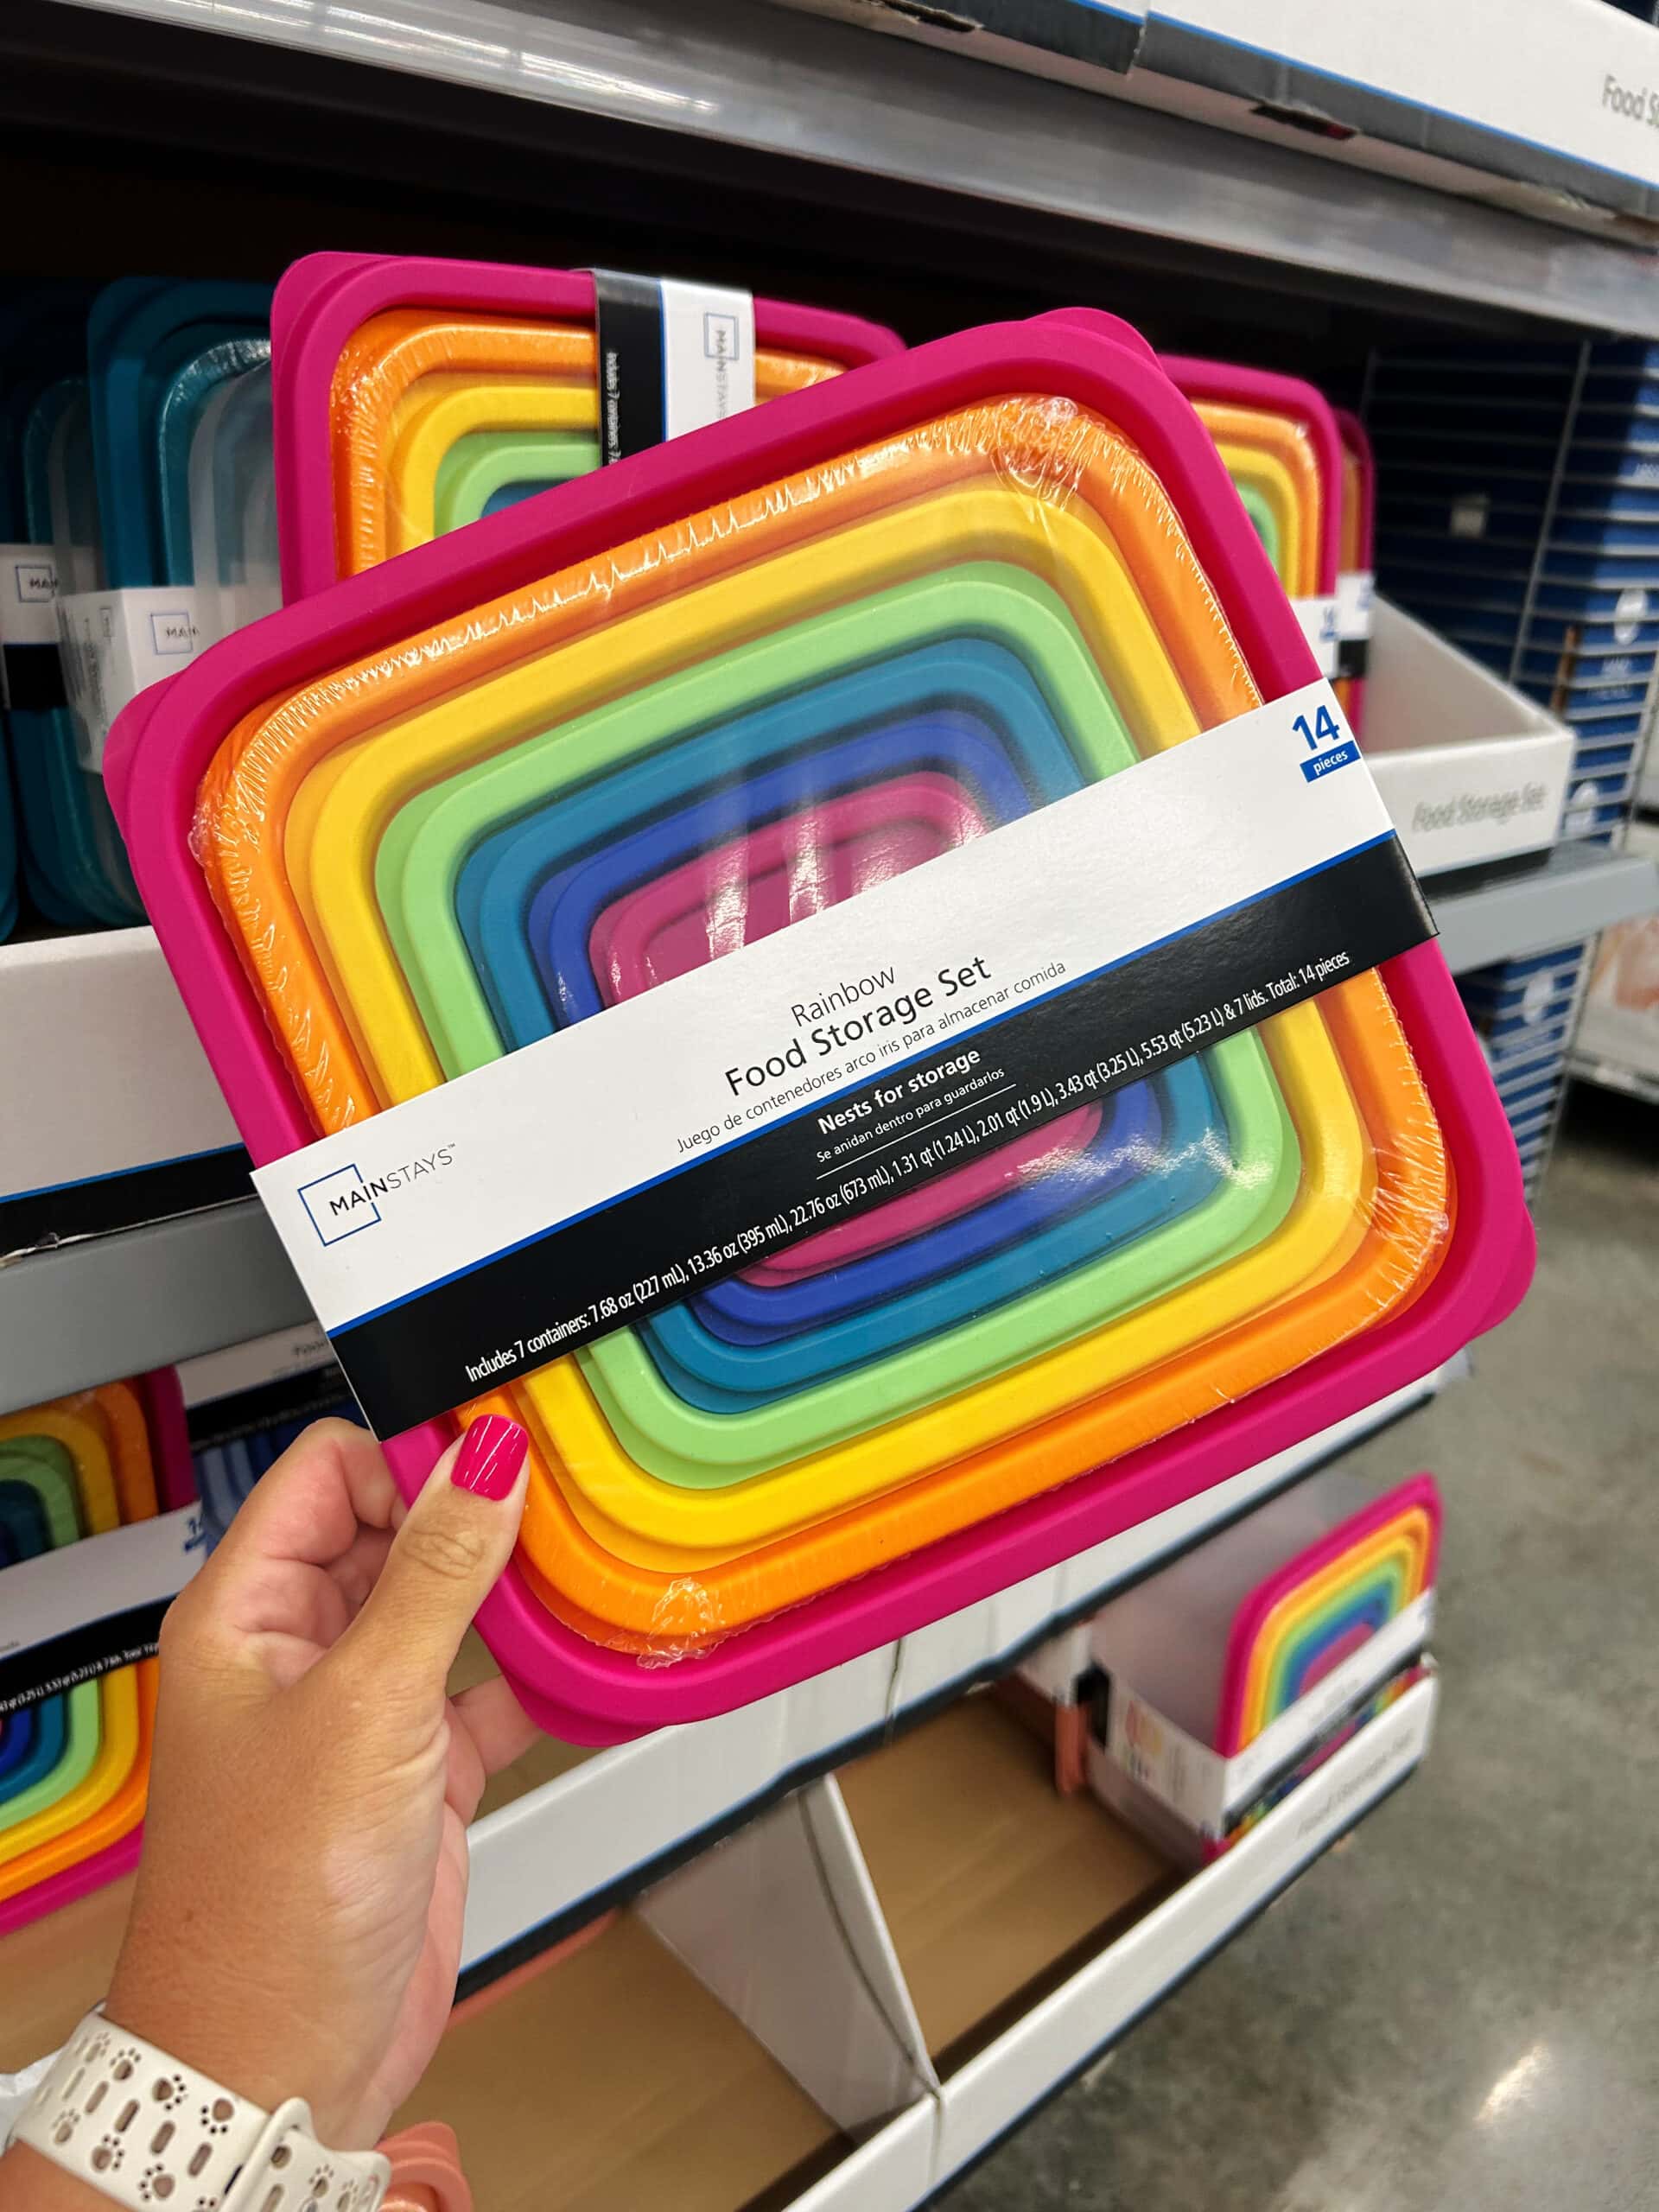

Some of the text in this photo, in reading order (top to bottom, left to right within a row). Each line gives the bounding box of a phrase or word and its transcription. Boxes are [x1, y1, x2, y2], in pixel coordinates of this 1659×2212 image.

[1602, 73, 1648, 121] Food
[1292, 704, 1340, 751] 14
[1313, 749, 1349, 776] pieces
[724, 957, 992, 1096] Food Storage Set
[790, 965, 896, 1027] Rainbow
[677, 961, 1066, 1154] Juego de contenedores arco iris para almacenar comida
[817, 1049, 982, 1135] Nests for storage
[817, 1068, 1005, 1163] Se anidan dentro para guardarlos
[465, 951, 1351, 1382] Includes 7 containers: 7.68 oz (227 mL), 13.36 oz (395 mL), 22.76 oz (673 mL), 1.31 qt (1.24 L), 2.01 qt (1.9 L), 3.43 qt (3.25 L), 5.53 qt (5.23 L) & 7 lids. Total: 14 pieces
